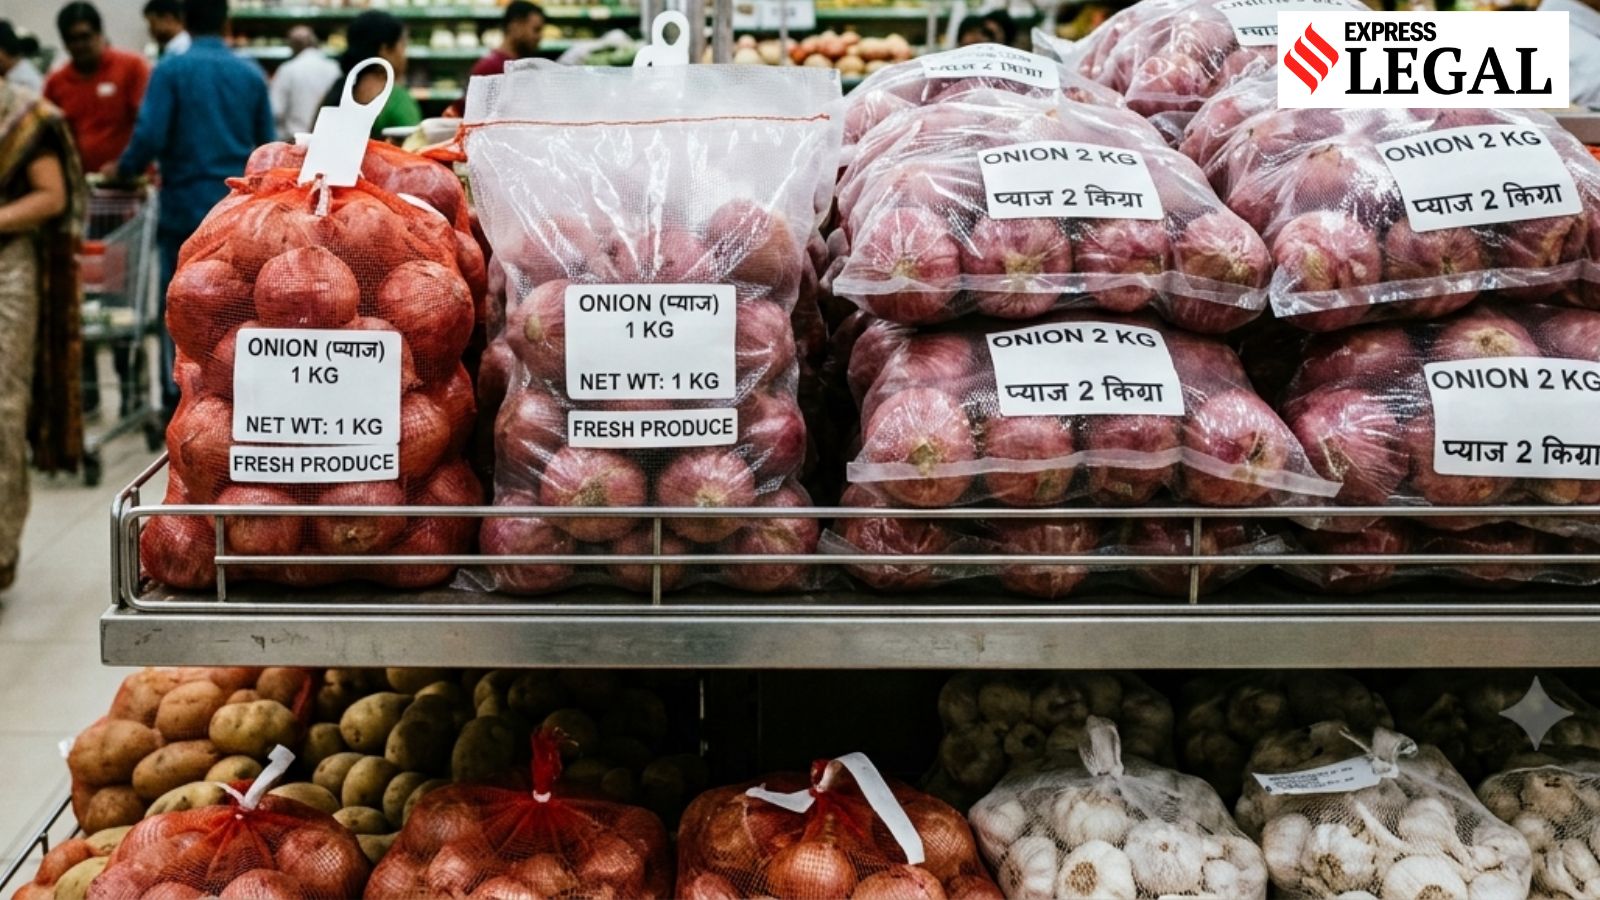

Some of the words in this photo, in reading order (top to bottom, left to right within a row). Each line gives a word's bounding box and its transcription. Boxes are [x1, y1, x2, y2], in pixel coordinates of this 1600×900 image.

[1384, 135, 1474, 161] ONION
[1478, 132, 1497, 149] 2
[1500, 130, 1542, 147] KG
[983, 147, 1069, 165] ONION
[1075, 148, 1093, 162] 2
[1098, 150, 1138, 166] KG
[1061, 188, 1078, 207] 2
[1084, 184, 1143, 208] किग्रा
[1411, 192, 1474, 215] प्याज
[1480, 189, 1499, 211] 2
[1502, 181, 1563, 208] किग्रा
[579, 293, 652, 313] ONION
[659, 294, 719, 316] (प्याज)
[625, 321, 634, 339] 1
[643, 320, 674, 339] KG
[992, 328, 1084, 347] ONION
[1091, 328, 1109, 344] 2
[1116, 329, 1157, 348] KG
[248, 337, 318, 358] ONION
[291, 365, 300, 384] 1
[308, 366, 339, 384] KG
[580, 373, 622, 391] NET
[626, 372, 664, 391] WT:
[672, 372, 681, 390] 1
[690, 371, 719, 390] KG
[1431, 367, 1530, 390] ONION
[1537, 368, 1555, 390] 2
[1561, 368, 1600, 392] KG
[1004, 382, 1070, 403] प्याज
[1078, 380, 1094, 401] 2
[1101, 374, 1164, 403] किग्रा
[246, 415, 286, 434] NET
[290, 417, 328, 435] WT:
[335, 418, 344, 435] 1
[352, 417, 383, 436] KG
[573, 419, 634, 438] FRESH
[640, 417, 733, 438] PRODUCE
[1442, 440, 1509, 463] प्याज
[1515, 439, 1533, 464] 2
[1541, 435, 1600, 466] किग्रा
[233, 455, 294, 473] FRESH
[300, 453, 394, 473] PRODUCE
